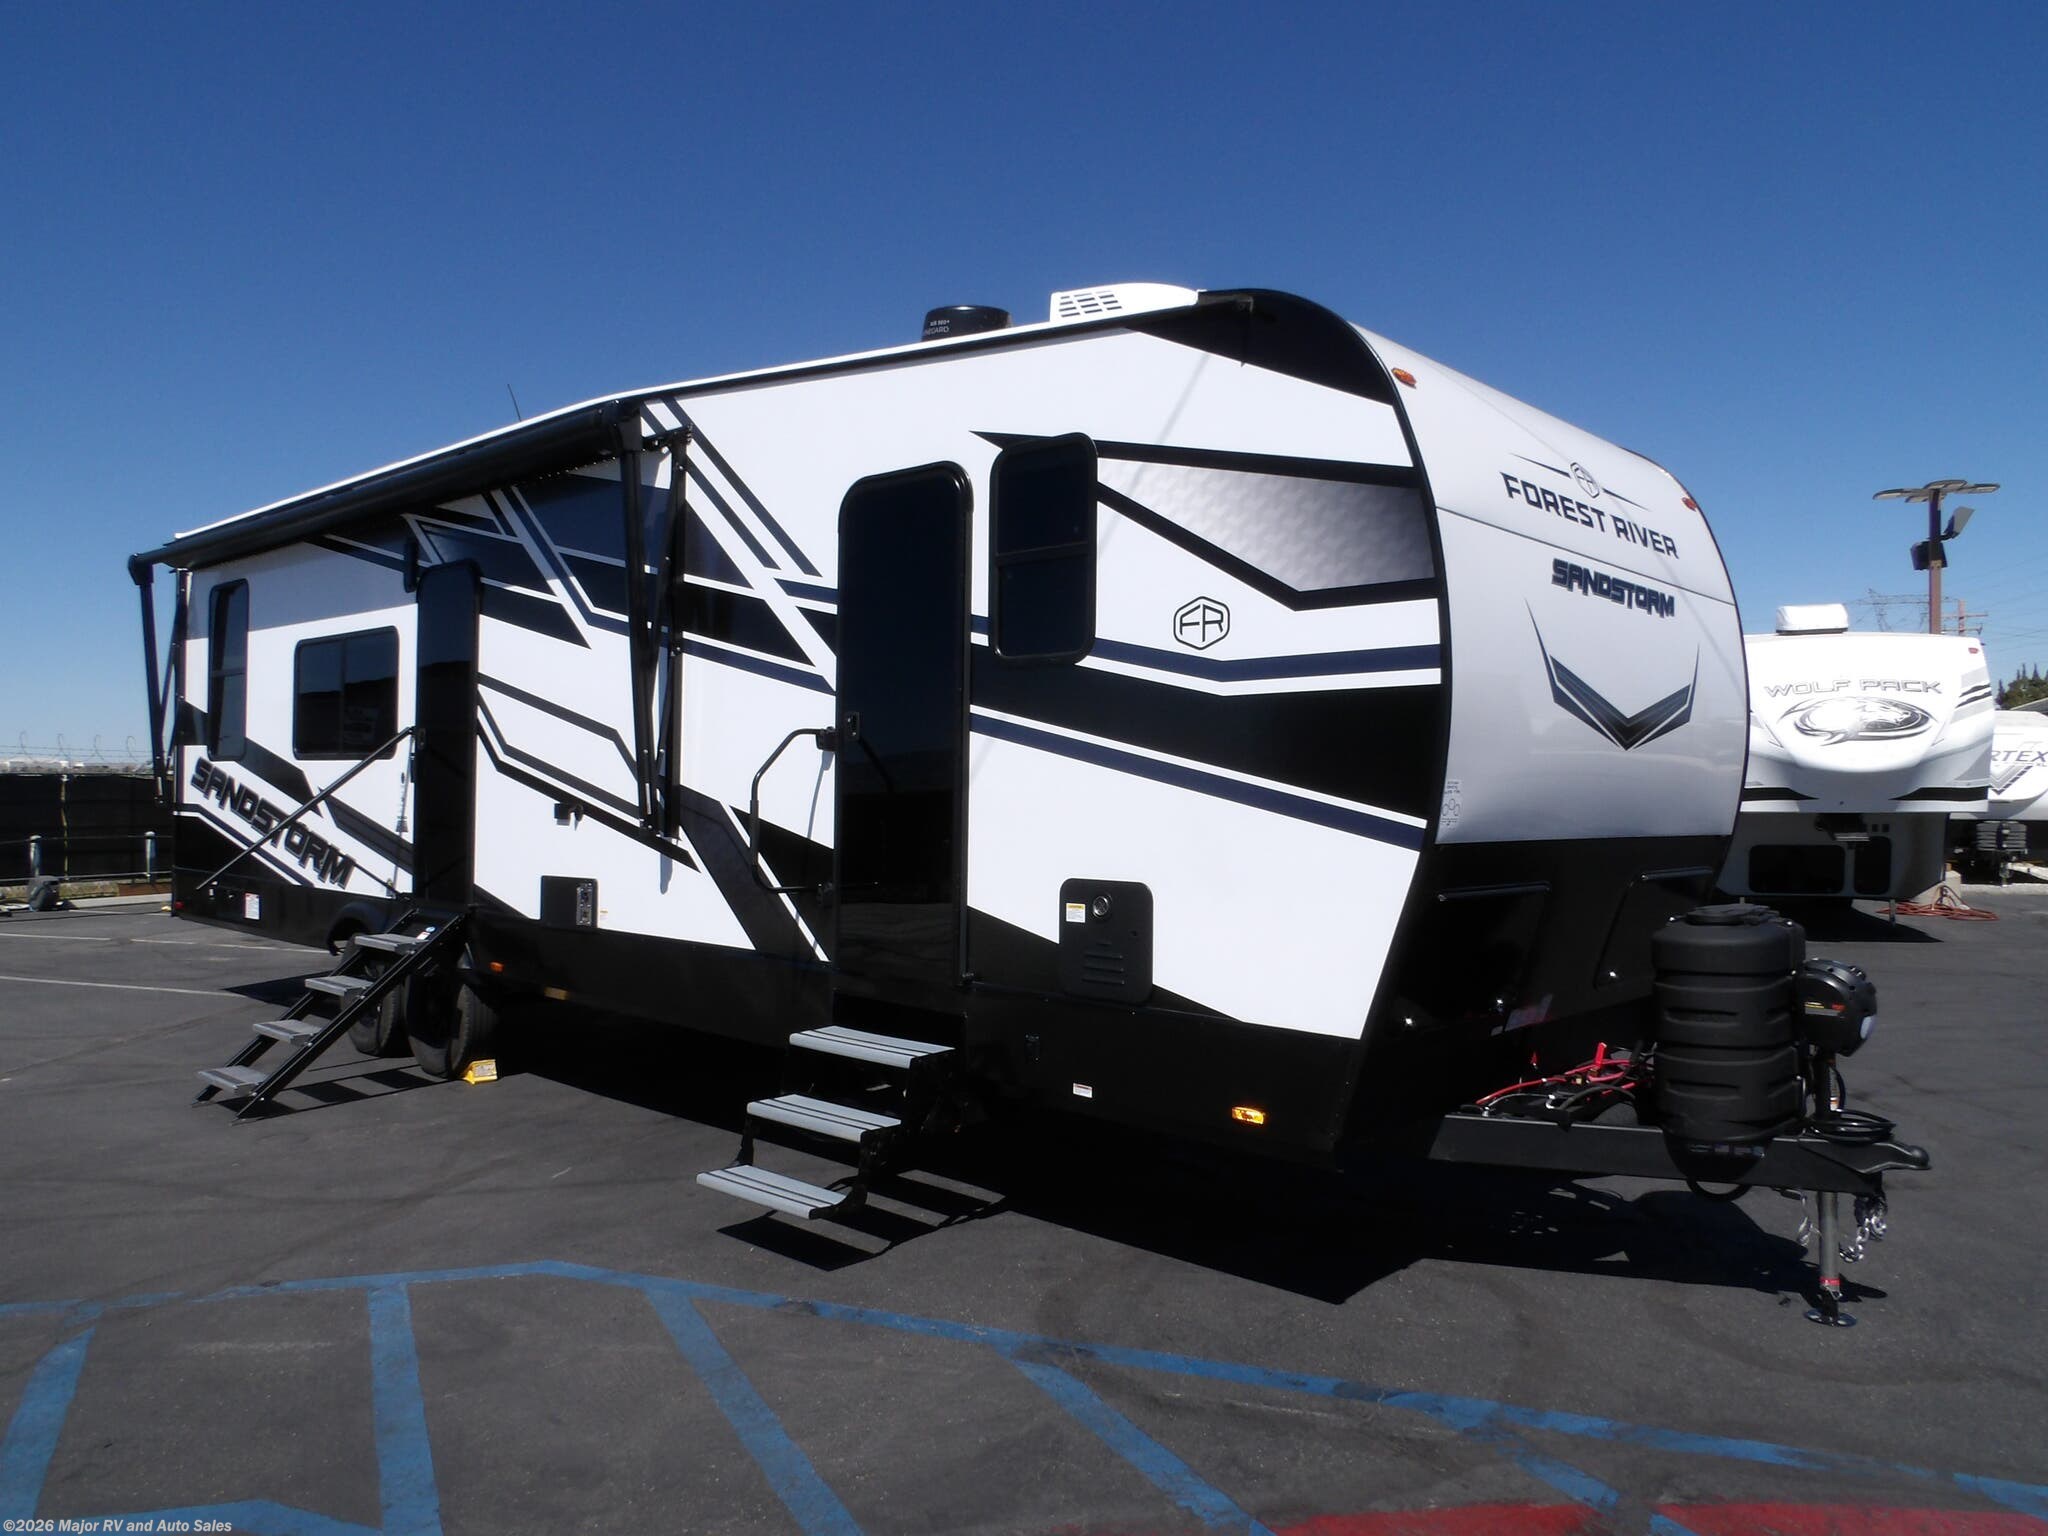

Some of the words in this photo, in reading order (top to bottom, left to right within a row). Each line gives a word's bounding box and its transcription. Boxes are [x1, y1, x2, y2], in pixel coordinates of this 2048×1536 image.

[1500, 472, 1606, 533] FOREST
[1609, 514, 1679, 559] RIVER
[1551, 558, 1675, 618] SANDSTORM
[1764, 680, 1851, 698] WOLF
[1859, 679, 1943, 695] PACK
[190, 757, 357, 890] SANDSTORM
